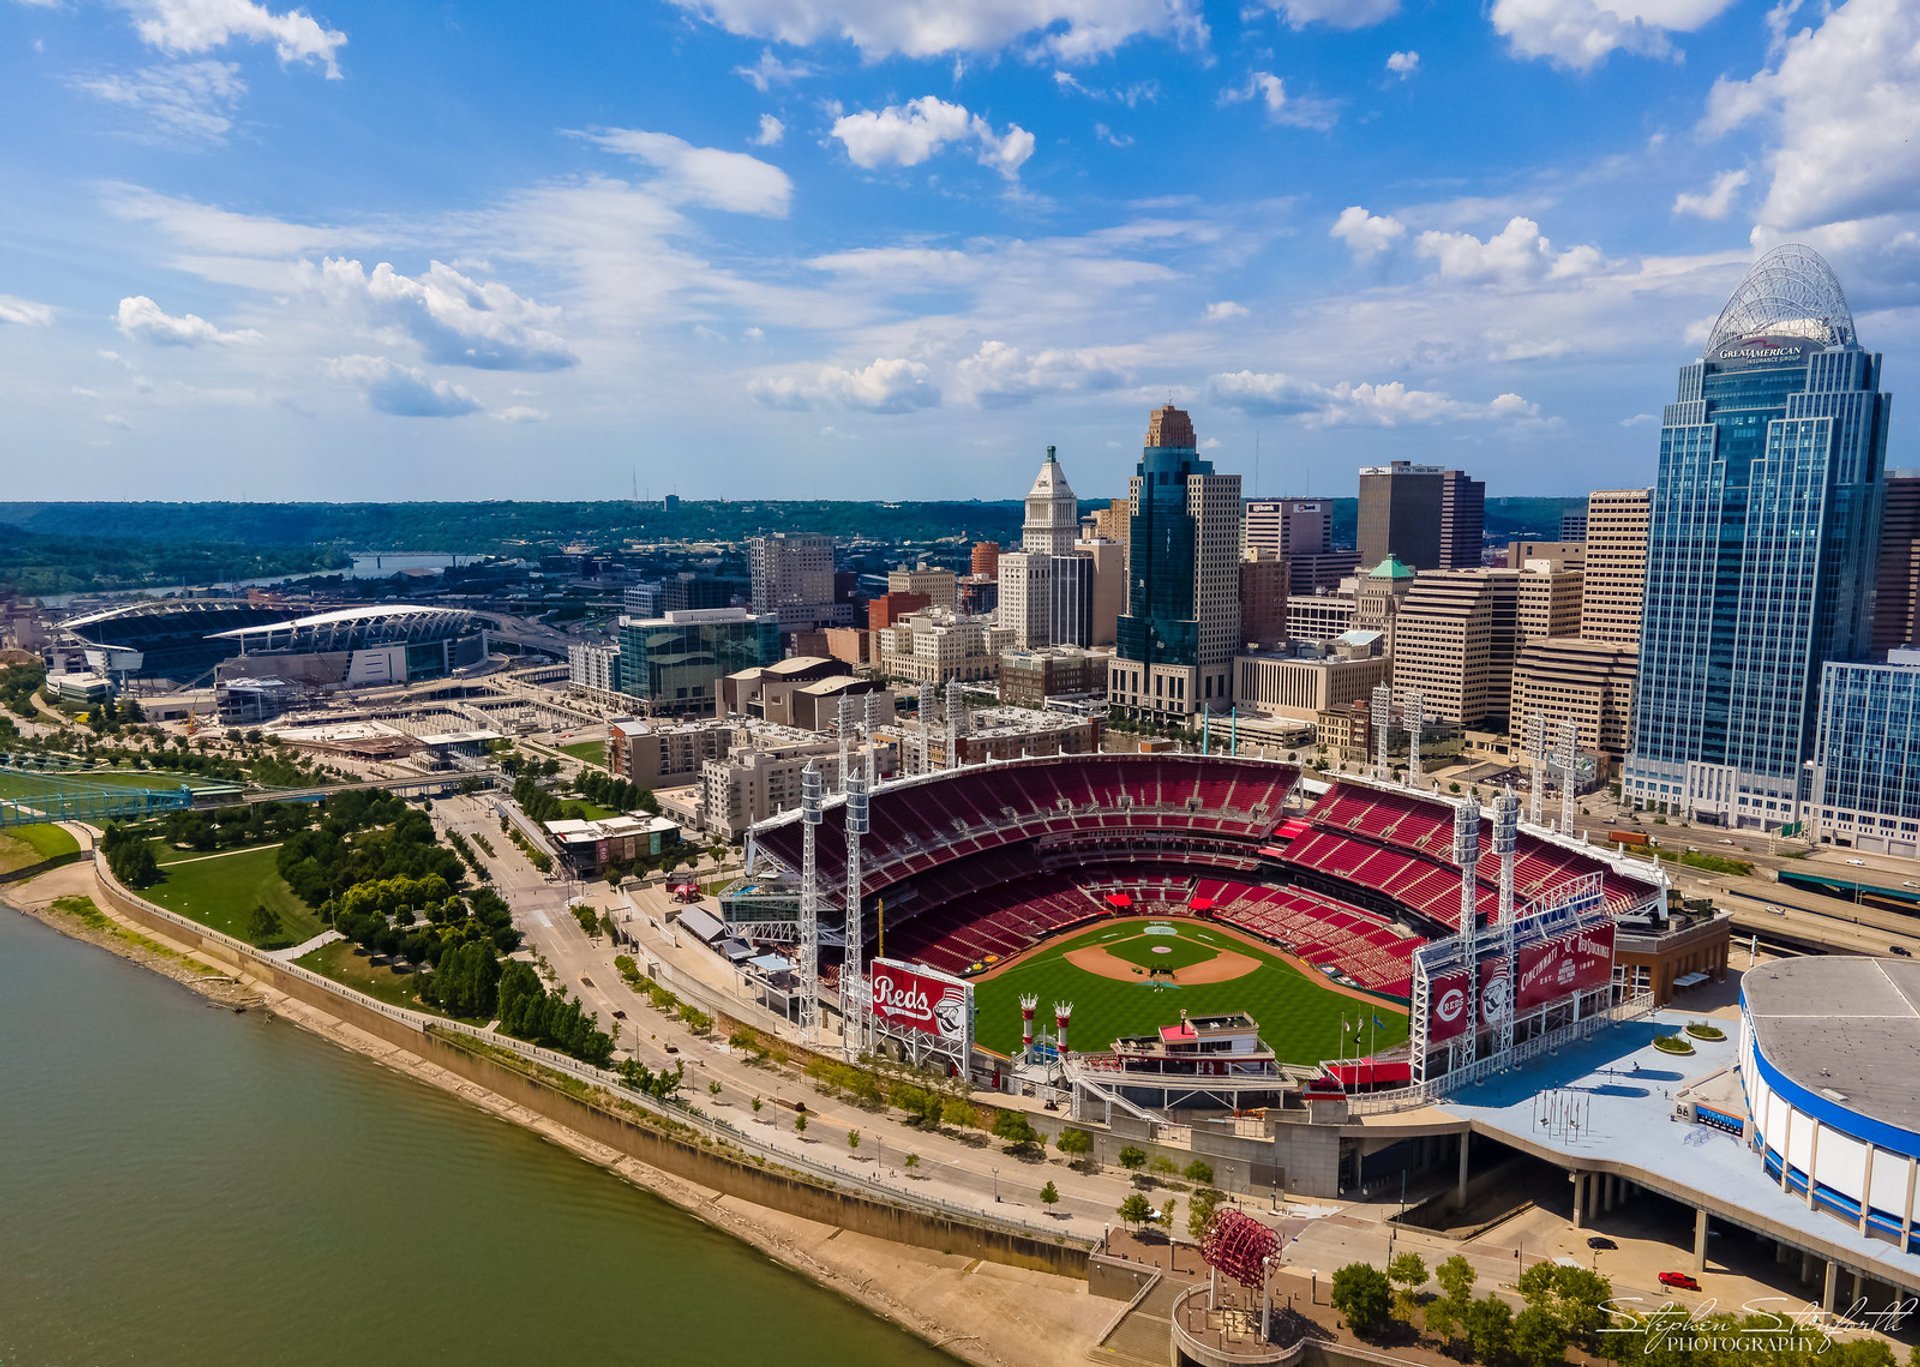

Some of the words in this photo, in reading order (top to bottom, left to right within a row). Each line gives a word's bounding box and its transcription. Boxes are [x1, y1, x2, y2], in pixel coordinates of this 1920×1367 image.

[1746, 356, 1778, 365] INSURANCE
[1779, 354, 1801, 362] GROUP
[1521, 946, 1558, 992] CINCINNATI
[873, 975, 932, 1020] Reds
[1444, 997, 1464, 1012] REDS
[1707, 1110, 1733, 1124] TICKETS
